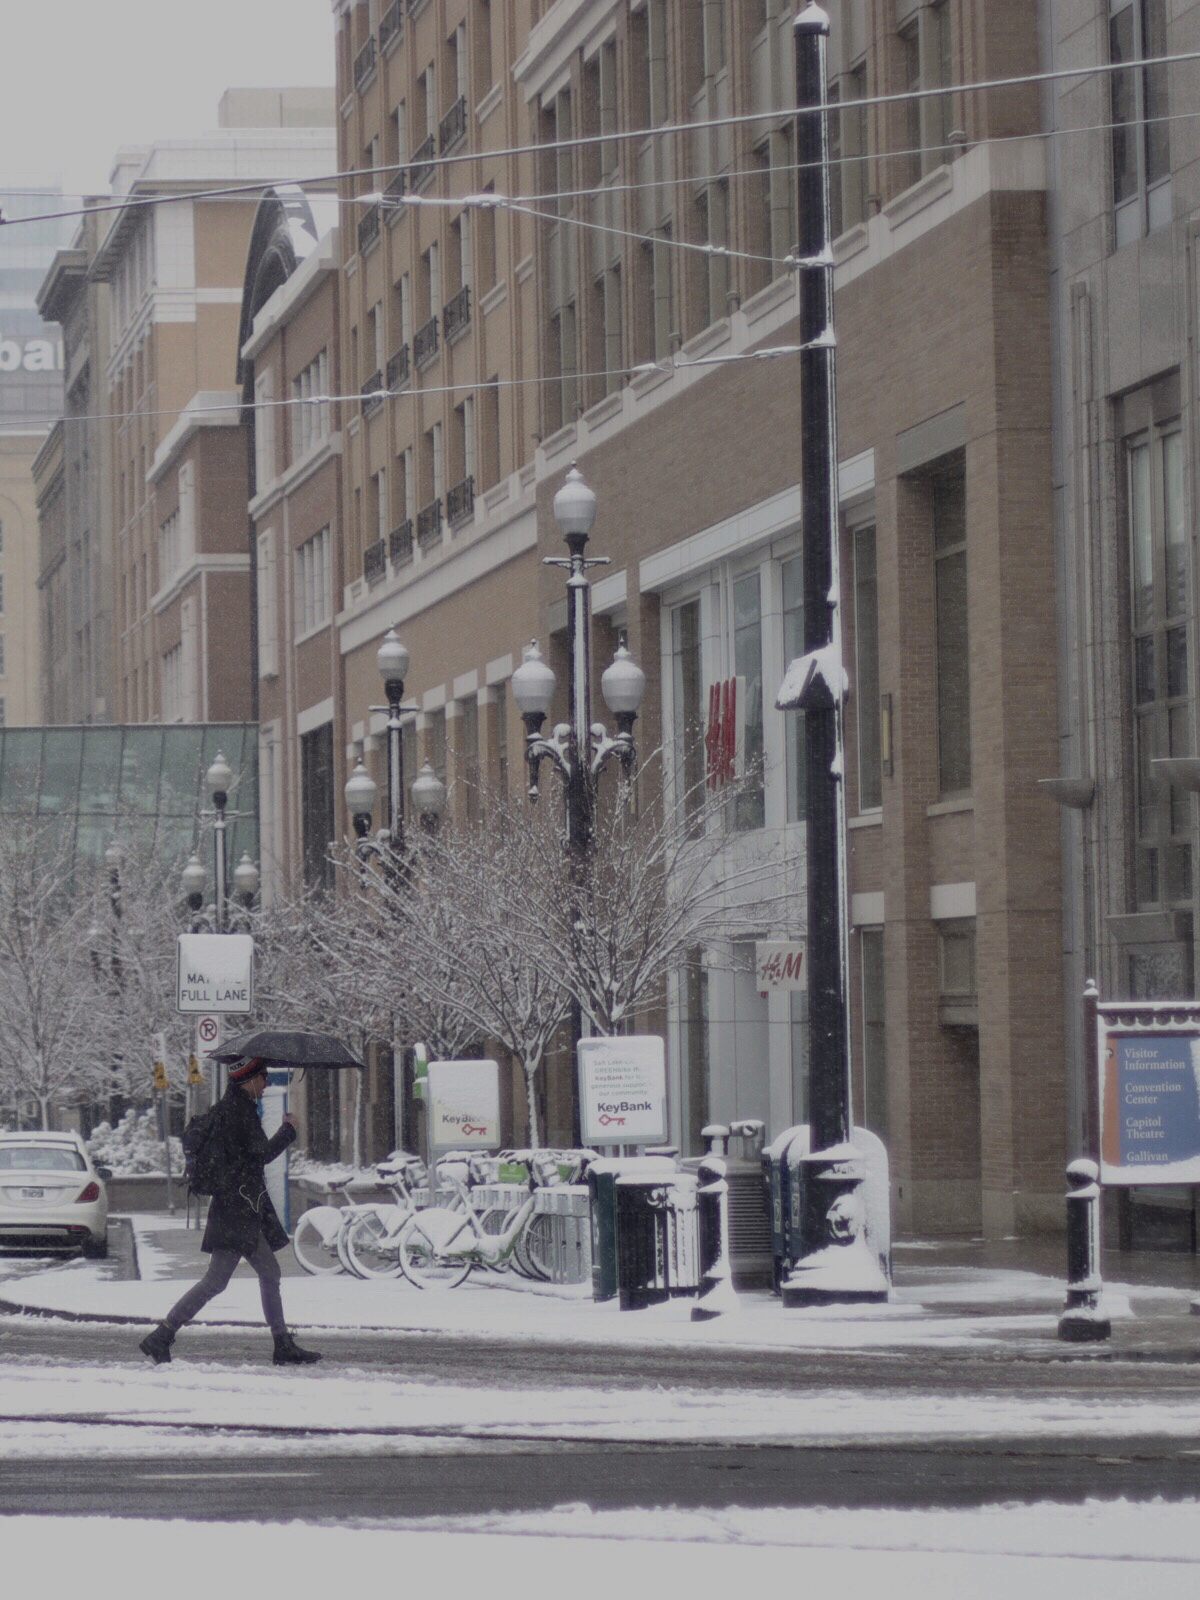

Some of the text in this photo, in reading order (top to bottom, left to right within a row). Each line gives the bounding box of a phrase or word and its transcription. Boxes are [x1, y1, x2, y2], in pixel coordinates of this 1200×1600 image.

[187, 973, 210, 984] MA
[181, 989, 248, 1001] FULL LANE
[1124, 1048, 1159, 1058] Visitor
[1124, 1060, 1186, 1070] Information
[1125, 1081, 1182, 1093] Convention
[1125, 1094, 1158, 1104] Center
[597, 1101, 652, 1114] KeyBank
[1126, 1116, 1161, 1129] Capitol
[1126, 1128, 1164, 1139] Theatre
[1126, 1151, 1169, 1162] Gallivan
